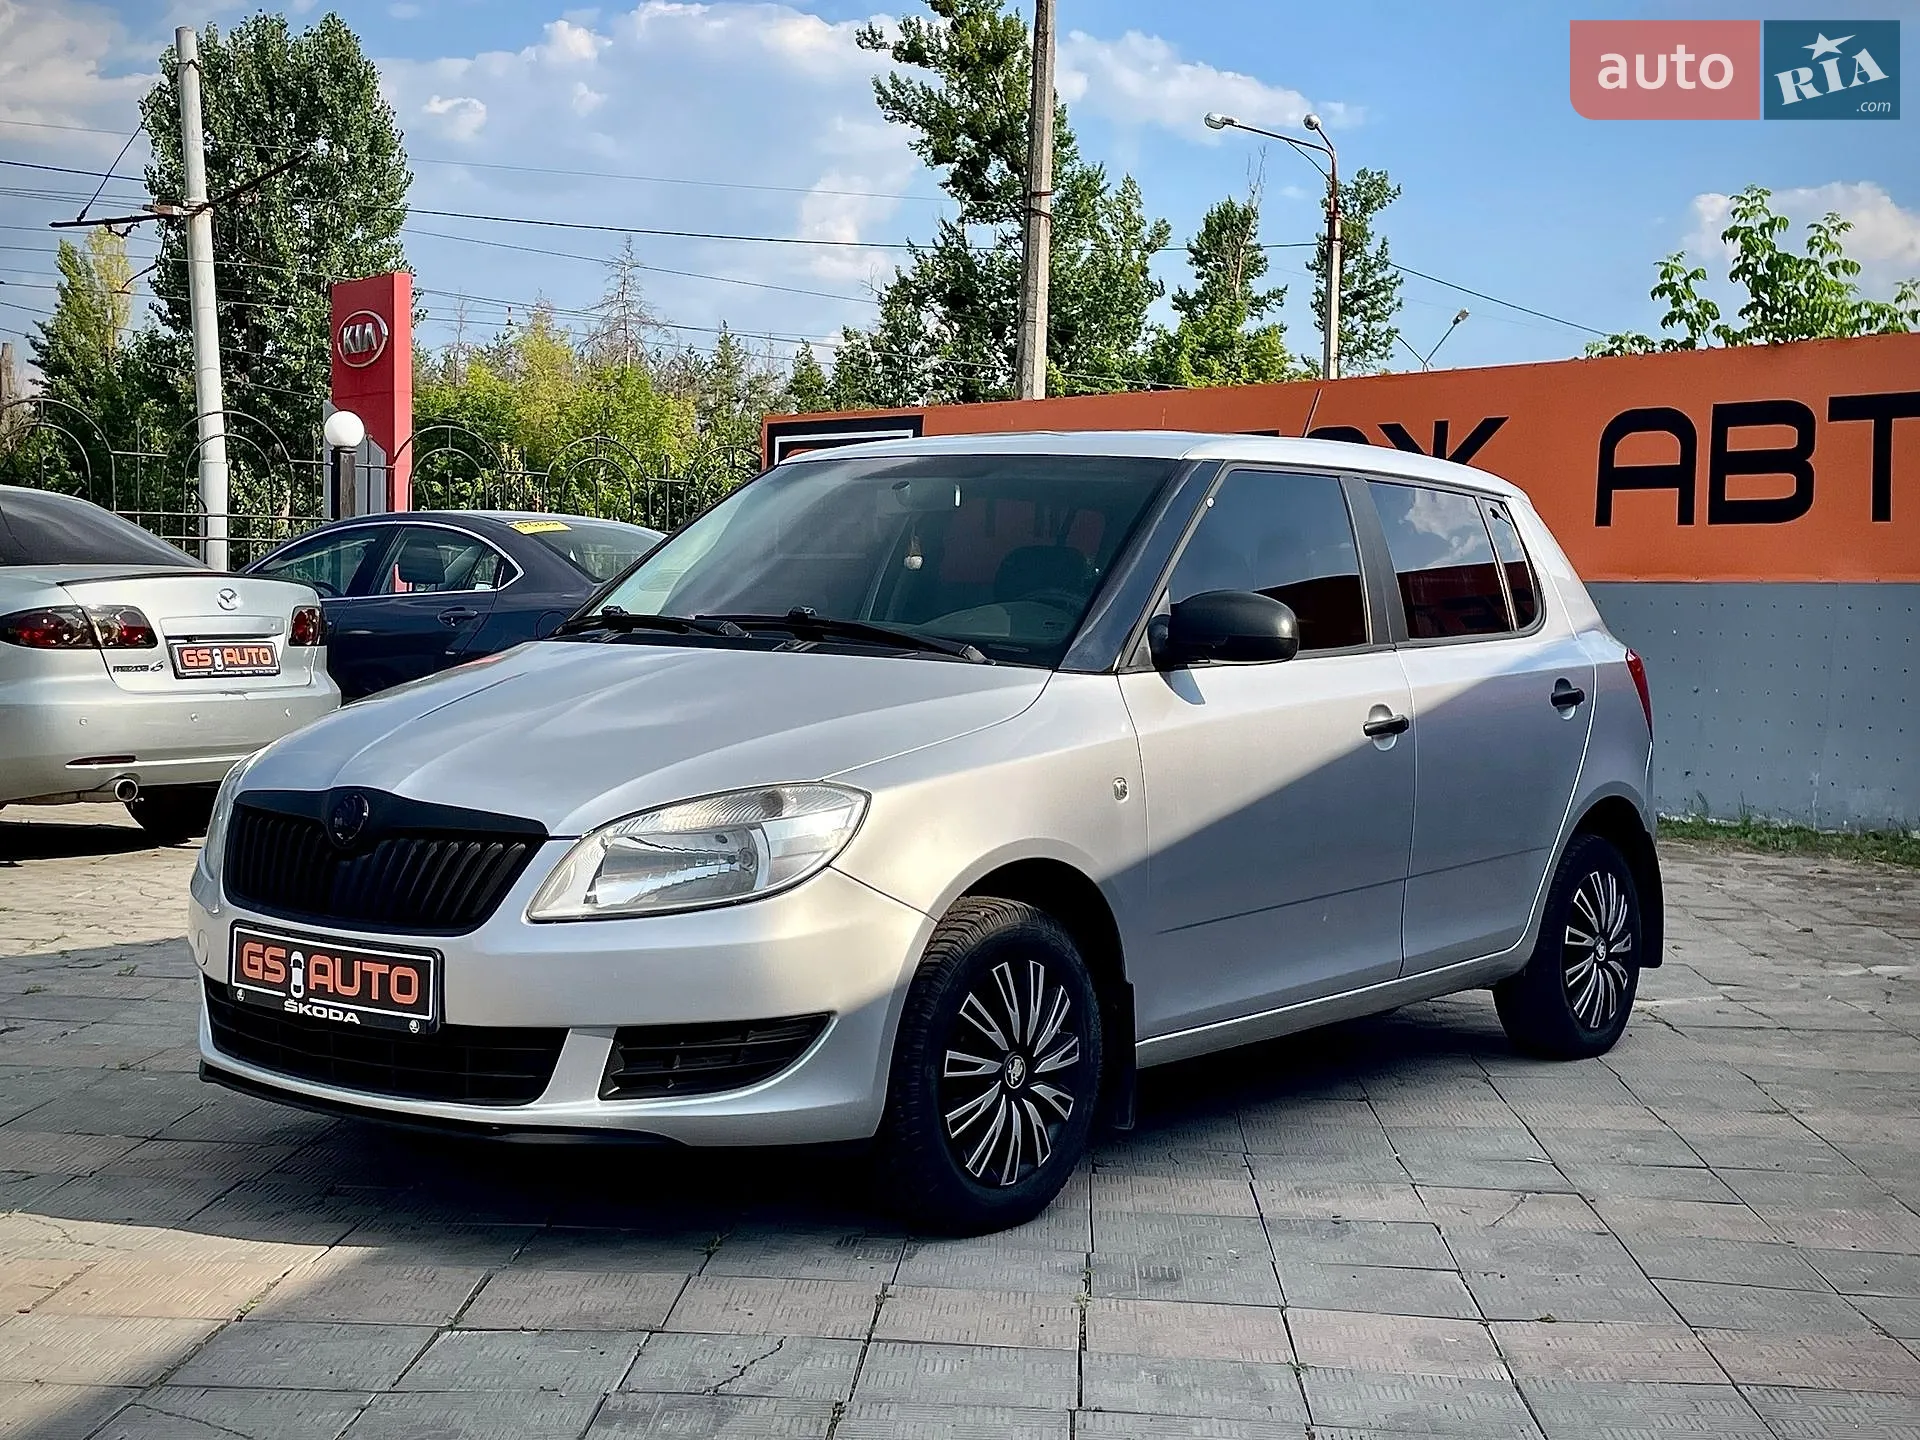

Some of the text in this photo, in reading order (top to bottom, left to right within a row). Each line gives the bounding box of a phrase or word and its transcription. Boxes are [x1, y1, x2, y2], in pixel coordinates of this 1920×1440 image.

[343, 322, 377, 355] KIA
[182, 647, 272, 667] GS AUTO
[242, 941, 419, 1005] GS AUTO
[283, 998, 361, 1025] ŠKODA
